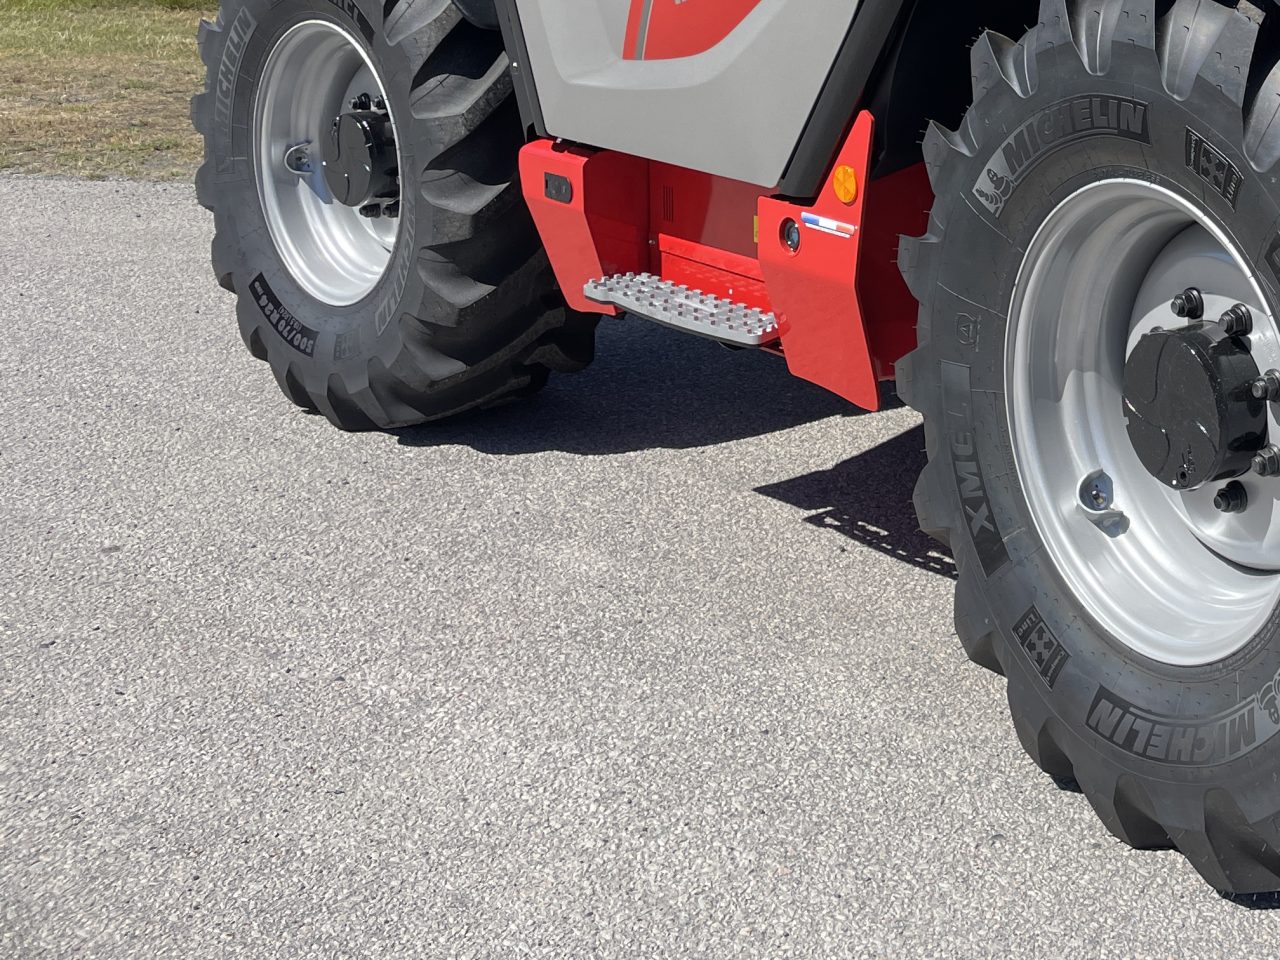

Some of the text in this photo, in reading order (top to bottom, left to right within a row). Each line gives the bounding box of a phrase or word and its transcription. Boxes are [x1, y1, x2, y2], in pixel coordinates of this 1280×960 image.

[1002, 97, 1146, 177] MICHELIN
[278, 319, 314, 353] 500/70
[1088, 698, 1257, 762] MICHELIN
